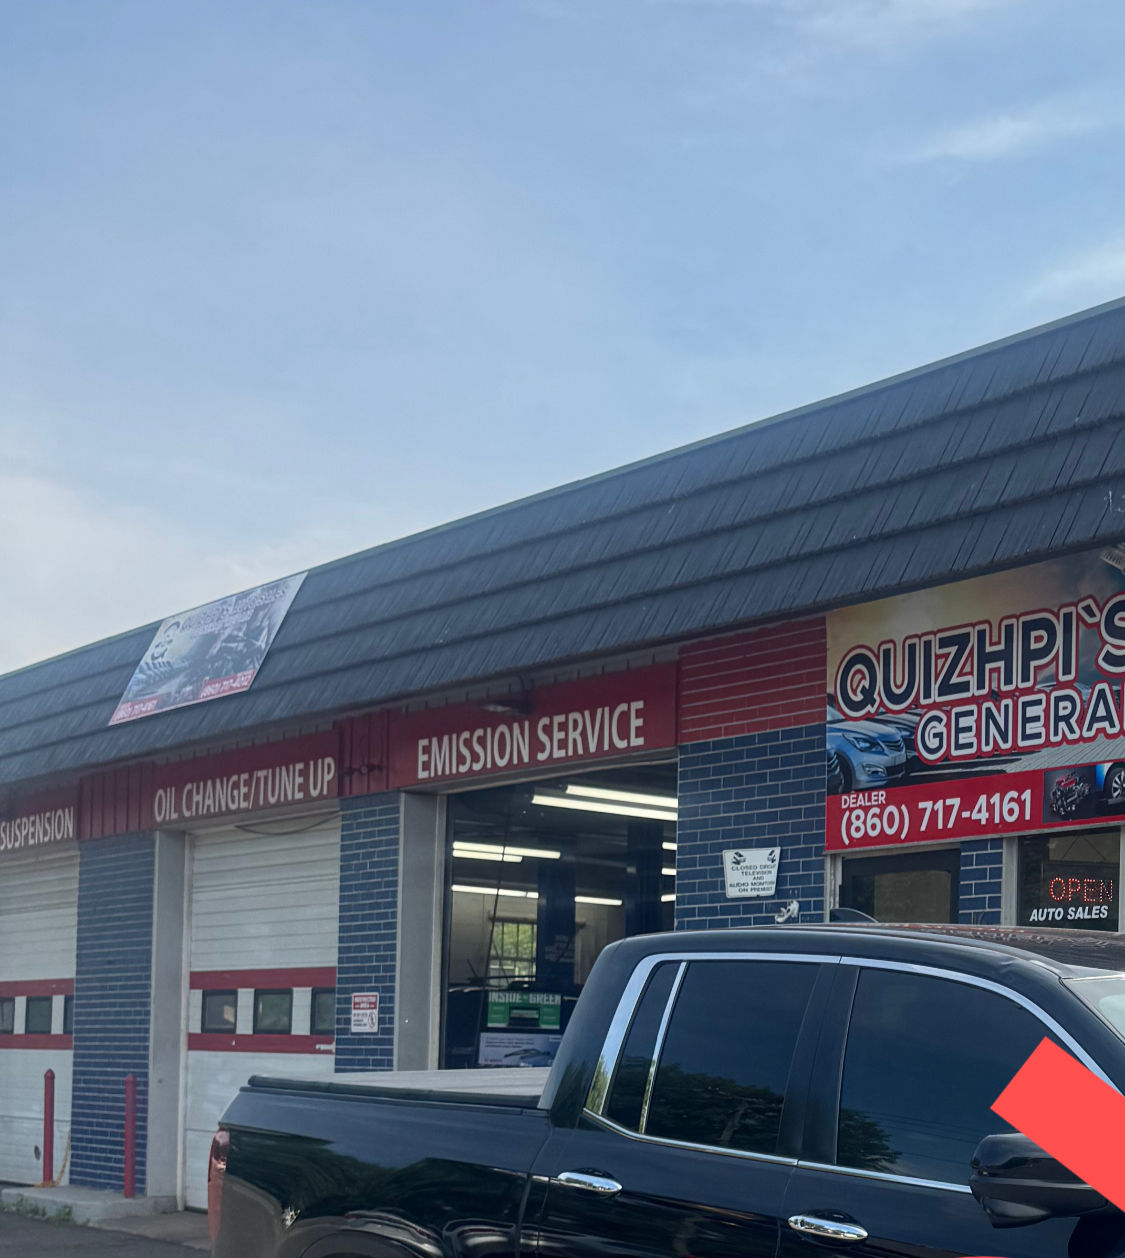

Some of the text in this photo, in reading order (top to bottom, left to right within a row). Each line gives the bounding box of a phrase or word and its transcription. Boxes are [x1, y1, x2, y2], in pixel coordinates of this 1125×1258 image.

[417, 700, 645, 780] EMISSION SERVICE
[154, 756, 336, 823] OIL CHANGE/TUNE UP
[841, 790, 886, 809] DEALER
[0, 807, 74, 851] SUSPENSION
[840, 789, 1032, 846] (860) 717-4161
[1050, 876, 1114, 903] OPEN
[1029, 905, 1109, 923] AUTO SALES
